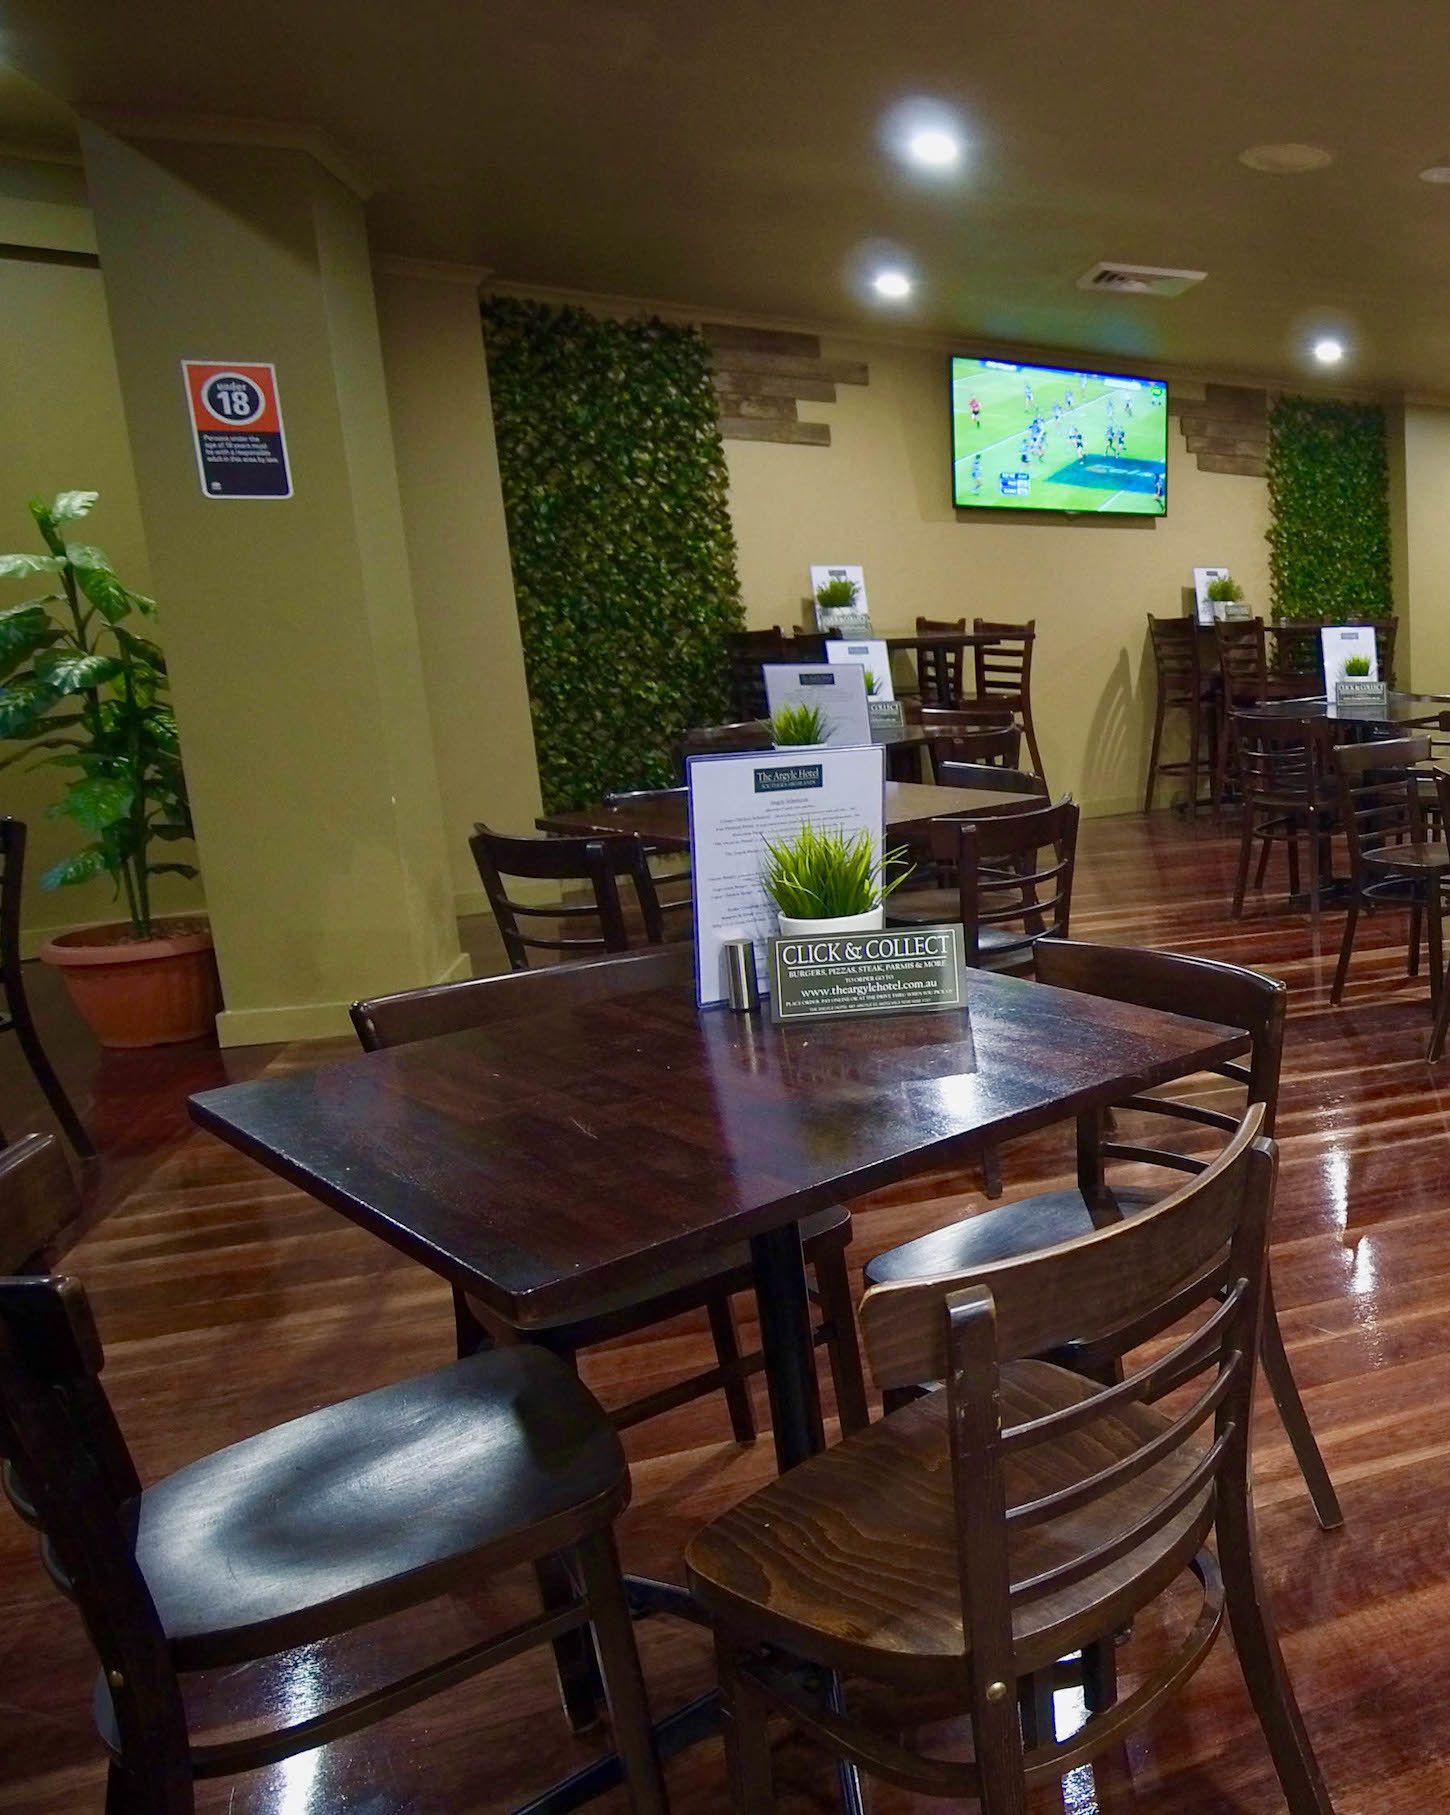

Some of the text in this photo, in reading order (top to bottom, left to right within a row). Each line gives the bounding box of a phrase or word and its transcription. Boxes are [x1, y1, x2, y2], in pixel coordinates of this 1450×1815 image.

[217, 391, 250, 416] 18
[782, 935, 950, 965] CLICK & COLLECT
[915, 960, 923, 969] &
[924, 959, 944, 968] MORE
[801, 980, 938, 997] www.theargylehotel.com.au
